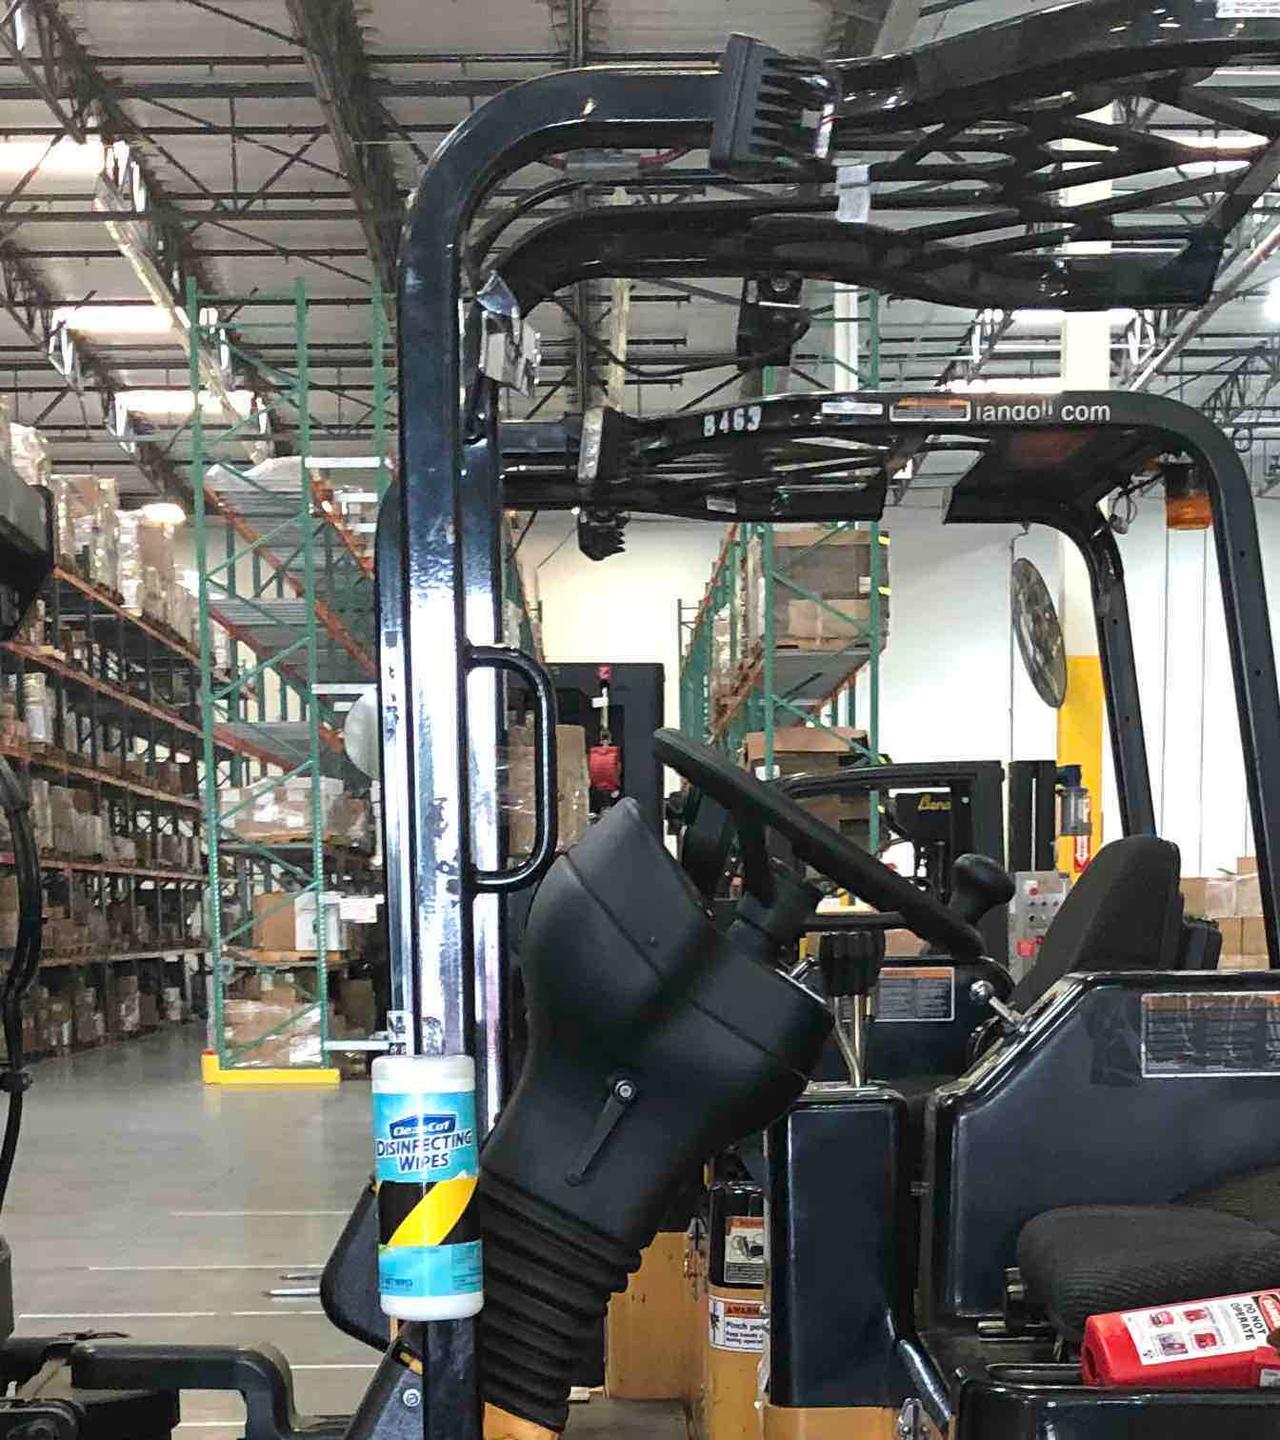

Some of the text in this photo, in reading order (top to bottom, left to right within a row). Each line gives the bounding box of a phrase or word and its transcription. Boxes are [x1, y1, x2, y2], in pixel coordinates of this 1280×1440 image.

[377, 1130, 473, 1157] DISINFECTING
[400, 1152, 449, 1172] WIPES
[1250, 1315, 1267, 1334] NOT
